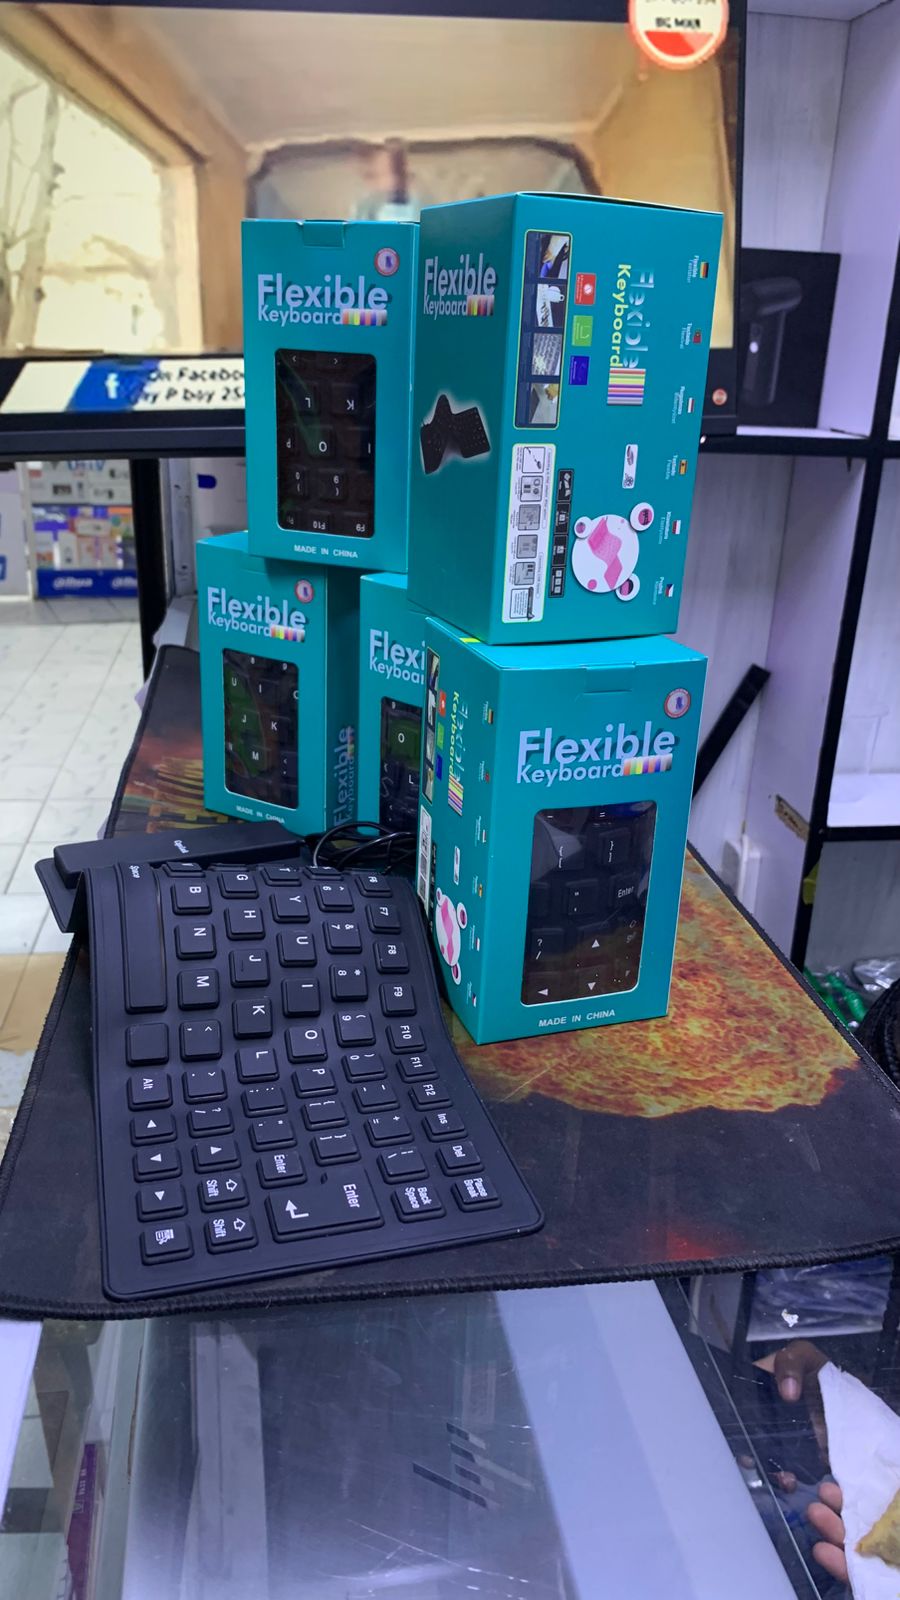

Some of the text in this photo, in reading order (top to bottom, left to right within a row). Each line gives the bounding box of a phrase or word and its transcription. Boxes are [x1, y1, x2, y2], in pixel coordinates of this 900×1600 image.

[424, 252, 496, 296] Flexible
[258, 273, 389, 309] Flexible
[423, 295, 468, 320] Keyboard
[258, 304, 344, 327] Keyboard
[610, 264, 631, 368] Keyboard
[221, 387, 245, 400] 25
[294, 544, 317, 554] MADE
[333, 549, 358, 558] CHINA
[207, 586, 306, 630] Flexible
[208, 611, 271, 637] Keyboard
[449, 690, 460, 776] Keyboard
[518, 721, 675, 765] Flexible
[333, 728, 349, 826] Flexible
[516, 761, 624, 787] Keyboard
[236, 805, 253, 815] MADE
[189, 886, 202, 894] B
[618, 885, 635, 898] Enter
[289, 895, 302, 903] Y
[243, 909, 257, 919] H
[379, 907, 389, 916] F7
[193, 927, 207, 936] N
[296, 936, 309, 945] U
[387, 944, 397, 955] F8
[249, 954, 262, 962] J
[196, 975, 210, 987] M
[393, 986, 403, 997] F9
[252, 1005, 266, 1015] K
[538, 1009, 616, 1027] MADE IN CHINA
[400, 1025, 412, 1040] F10
[255, 1050, 268, 1059] L
[410, 1056, 423, 1068] F11
[142, 1078, 154, 1090] Alt
[423, 1084, 436, 1096] F12
[437, 1113, 448, 1124] Ins
[452, 1145, 466, 1158] Del
[273, 1154, 287, 1174] Enter
[206, 1179, 220, 1197] Shift
[463, 1179, 480, 1198] Break
[473, 1177, 488, 1197] Pause
[343, 1183, 361, 1208] Enter
[404, 1186, 420, 1209] Space
[417, 1186, 432, 1205] Back
[212, 1218, 227, 1238] Shift
